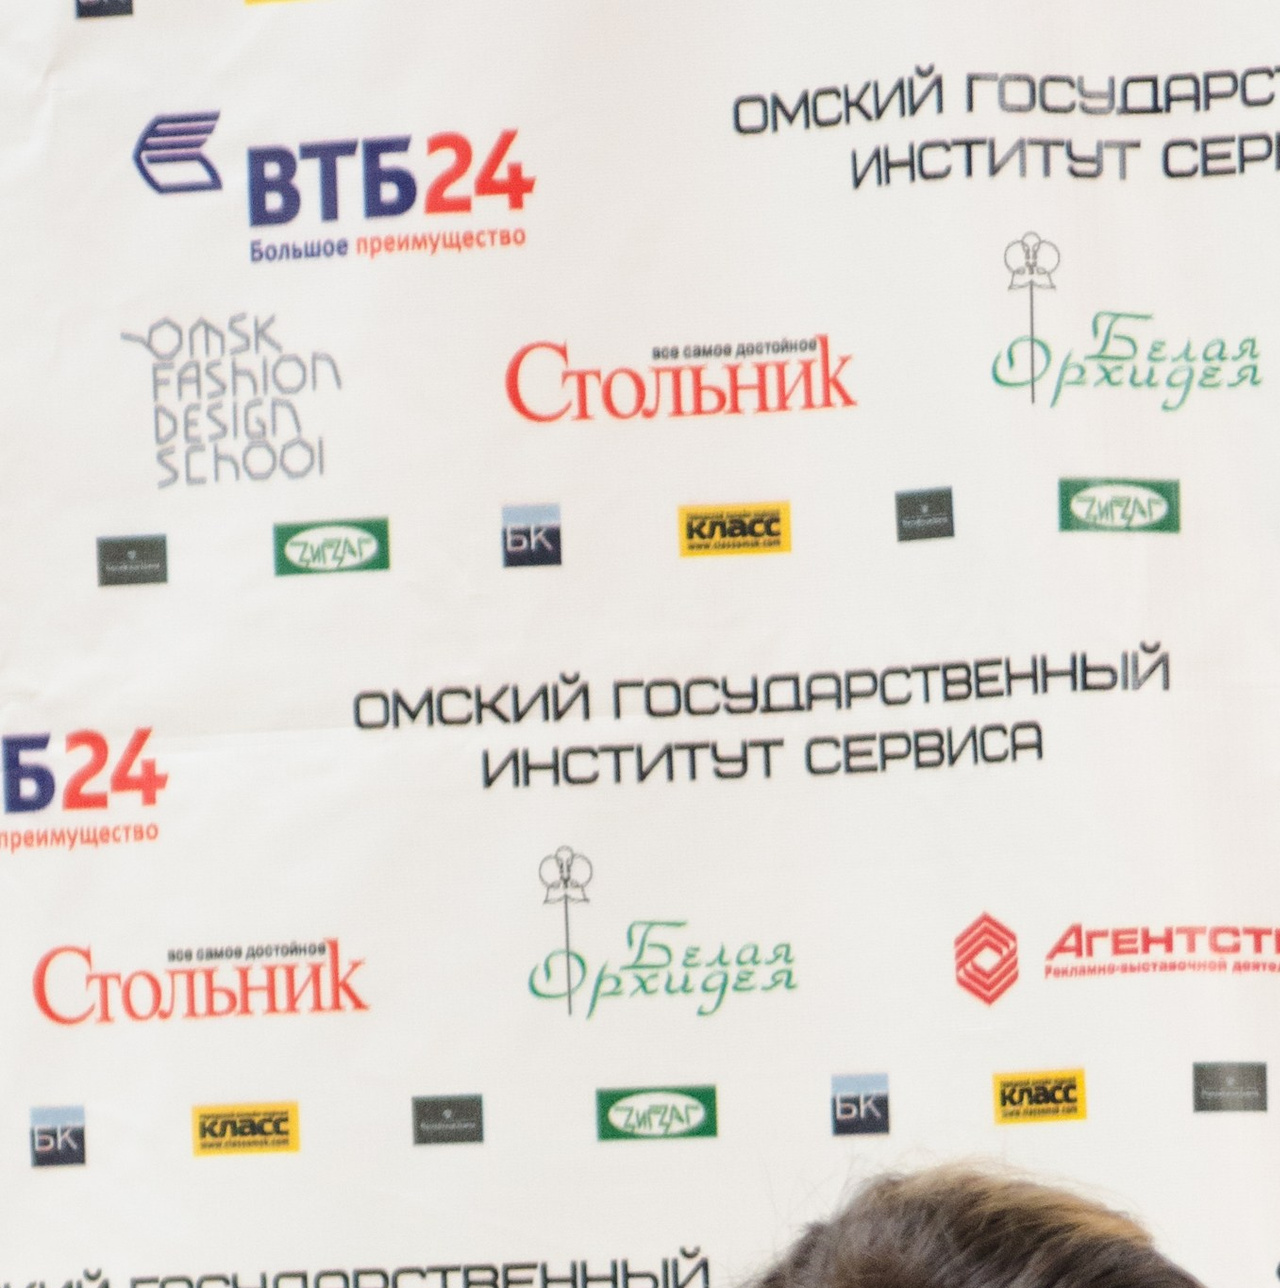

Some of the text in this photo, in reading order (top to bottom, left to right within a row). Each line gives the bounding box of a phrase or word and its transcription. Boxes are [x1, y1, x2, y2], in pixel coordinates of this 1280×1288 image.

[733, 65, 943, 135] ОМСКИЙ
[248, 130, 535, 227] ВТБ24
[851, 138, 1141, 190] ИНСТИТУТ
[250, 228, 526, 263] Большое преимущество
[684, 341, 731, 359] самое
[735, 338, 818, 356] достойное
[1091, 310, 1261, 363] Белая
[505, 335, 857, 423] Стольник
[991, 334, 1264, 411] Орхидея
[506, 527, 554, 553] БК
[354, 642, 1169, 729] ОМСКИЙ ГОСУДАРСТВЕННЫЙ
[483, 721, 1043, 788] ИНСТИТУТ СЕРВИСА
[198, 946, 242, 961] самое
[246, 940, 328, 960] достойное
[619, 920, 796, 971] Белая
[33, 938, 369, 1026] Стольник
[527, 949, 799, 1019] Орхидея
[834, 1095, 881, 1121] БК
[34, 1127, 77, 1152] БК
